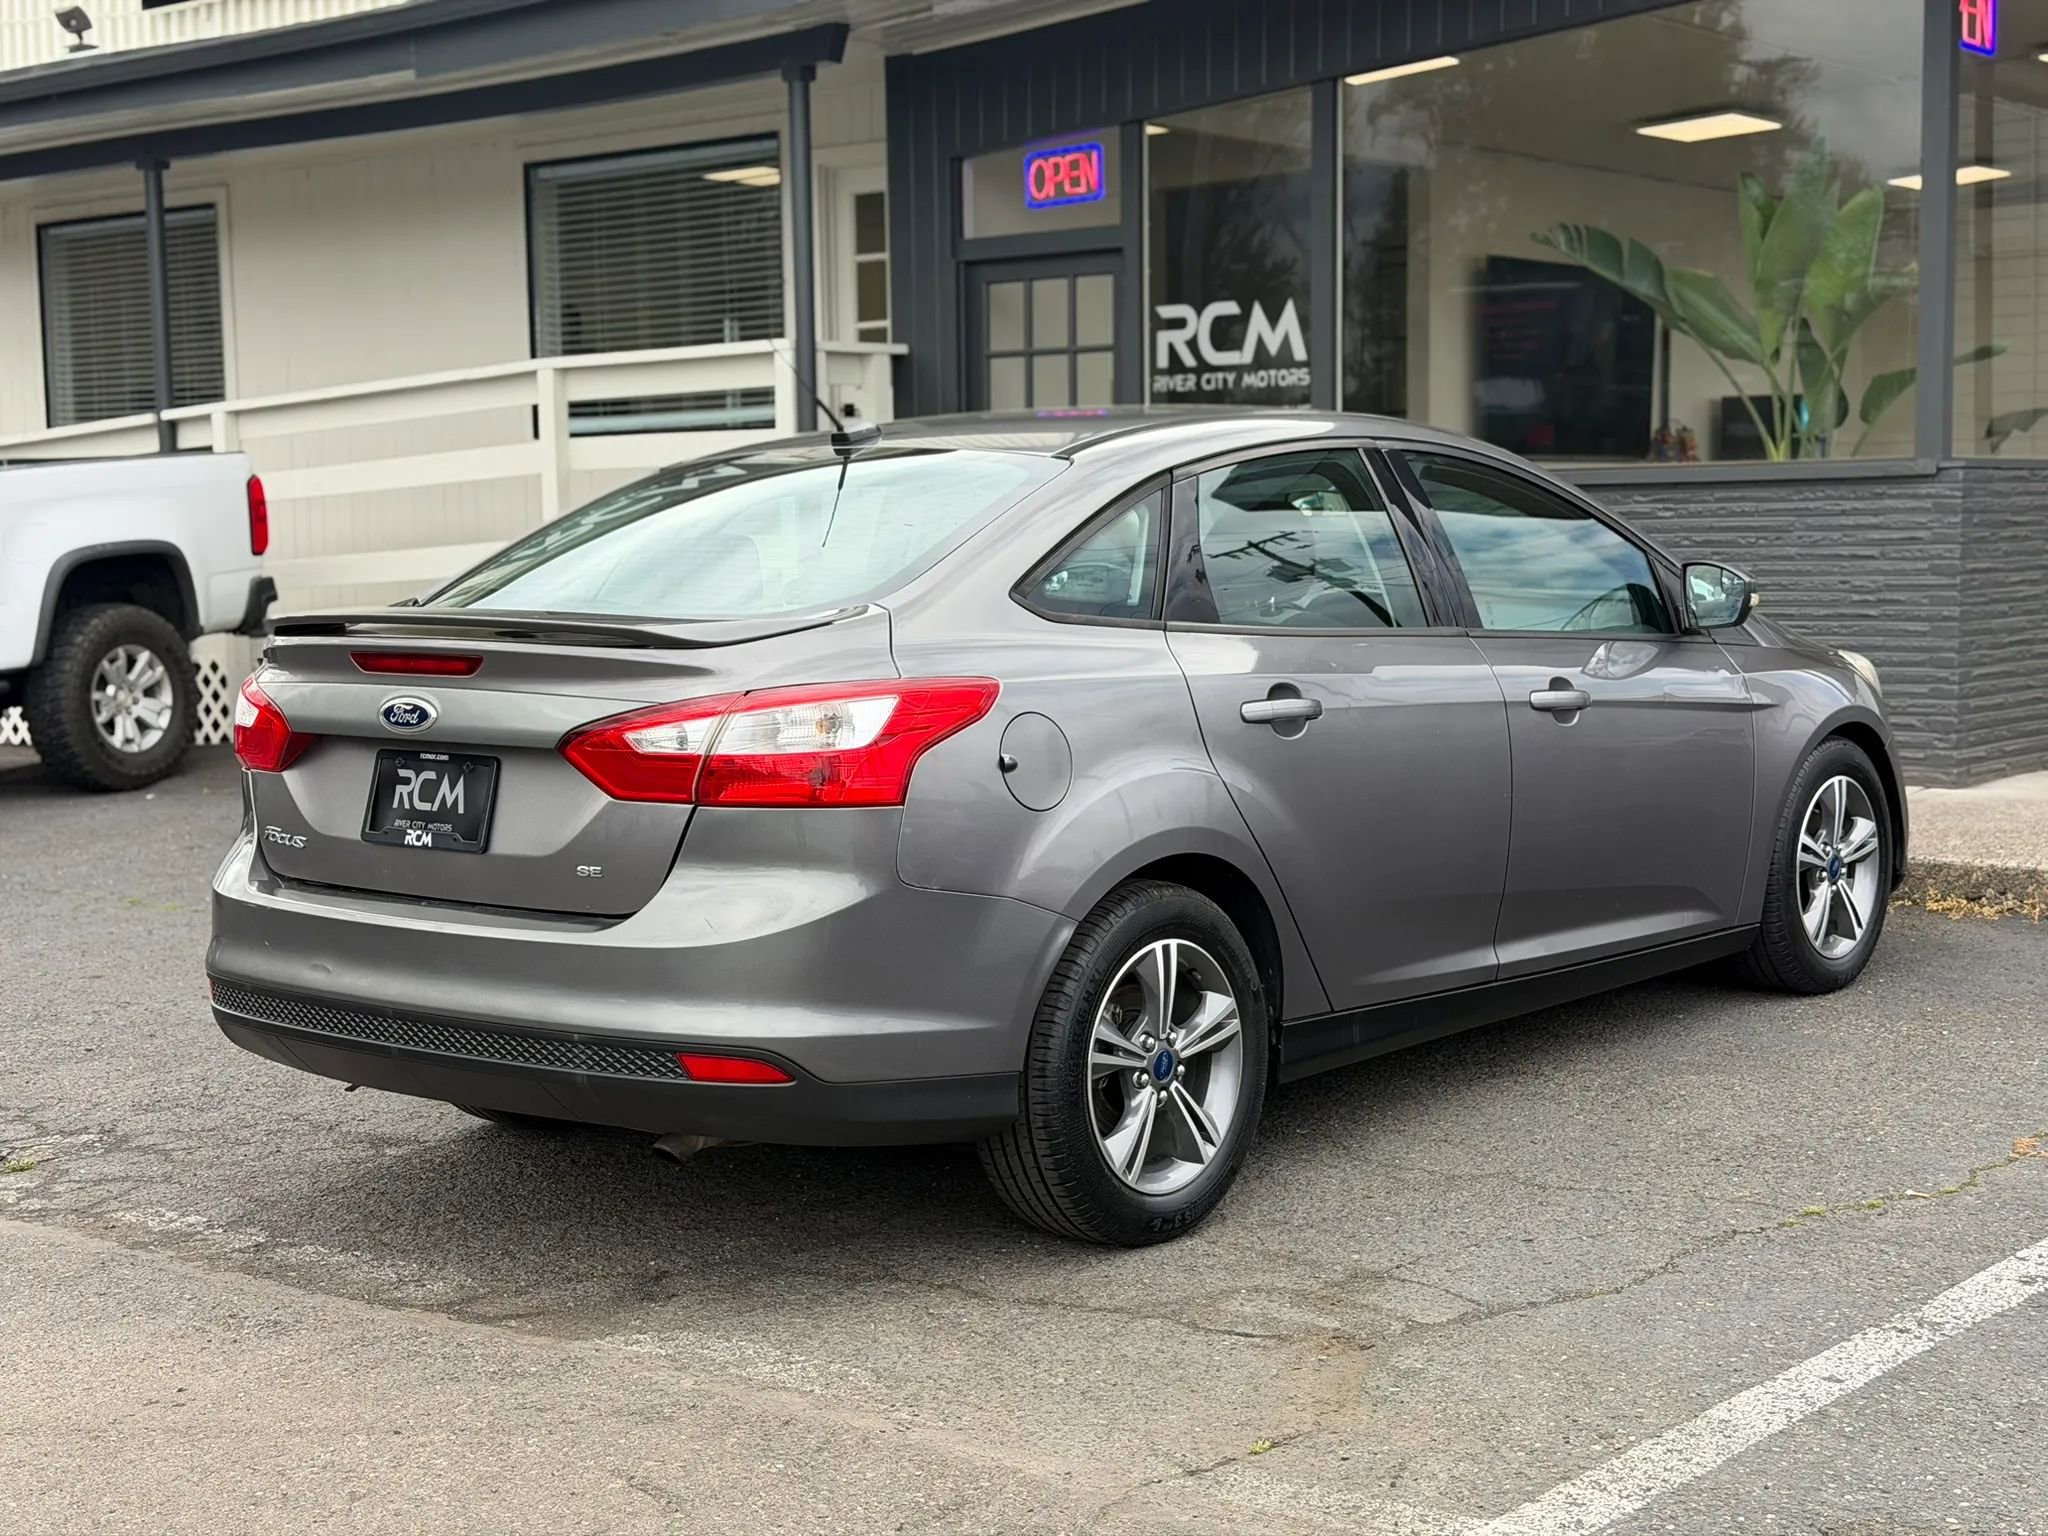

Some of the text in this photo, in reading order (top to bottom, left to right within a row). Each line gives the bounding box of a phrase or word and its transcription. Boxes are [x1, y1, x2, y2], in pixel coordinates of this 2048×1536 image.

[1028, 149, 1099, 201] OPEN
[1154, 297, 1309, 370] RCM
[1152, 367, 1312, 393] RIVER CITY MOTORS
[389, 703, 421, 724] Ford
[392, 768, 465, 815] RCM
[263, 825, 308, 849] Focus
[393, 818, 453, 832] RIVER CITY MOTORS
[404, 828, 432, 848] RCM
[576, 865, 602, 878] SE
